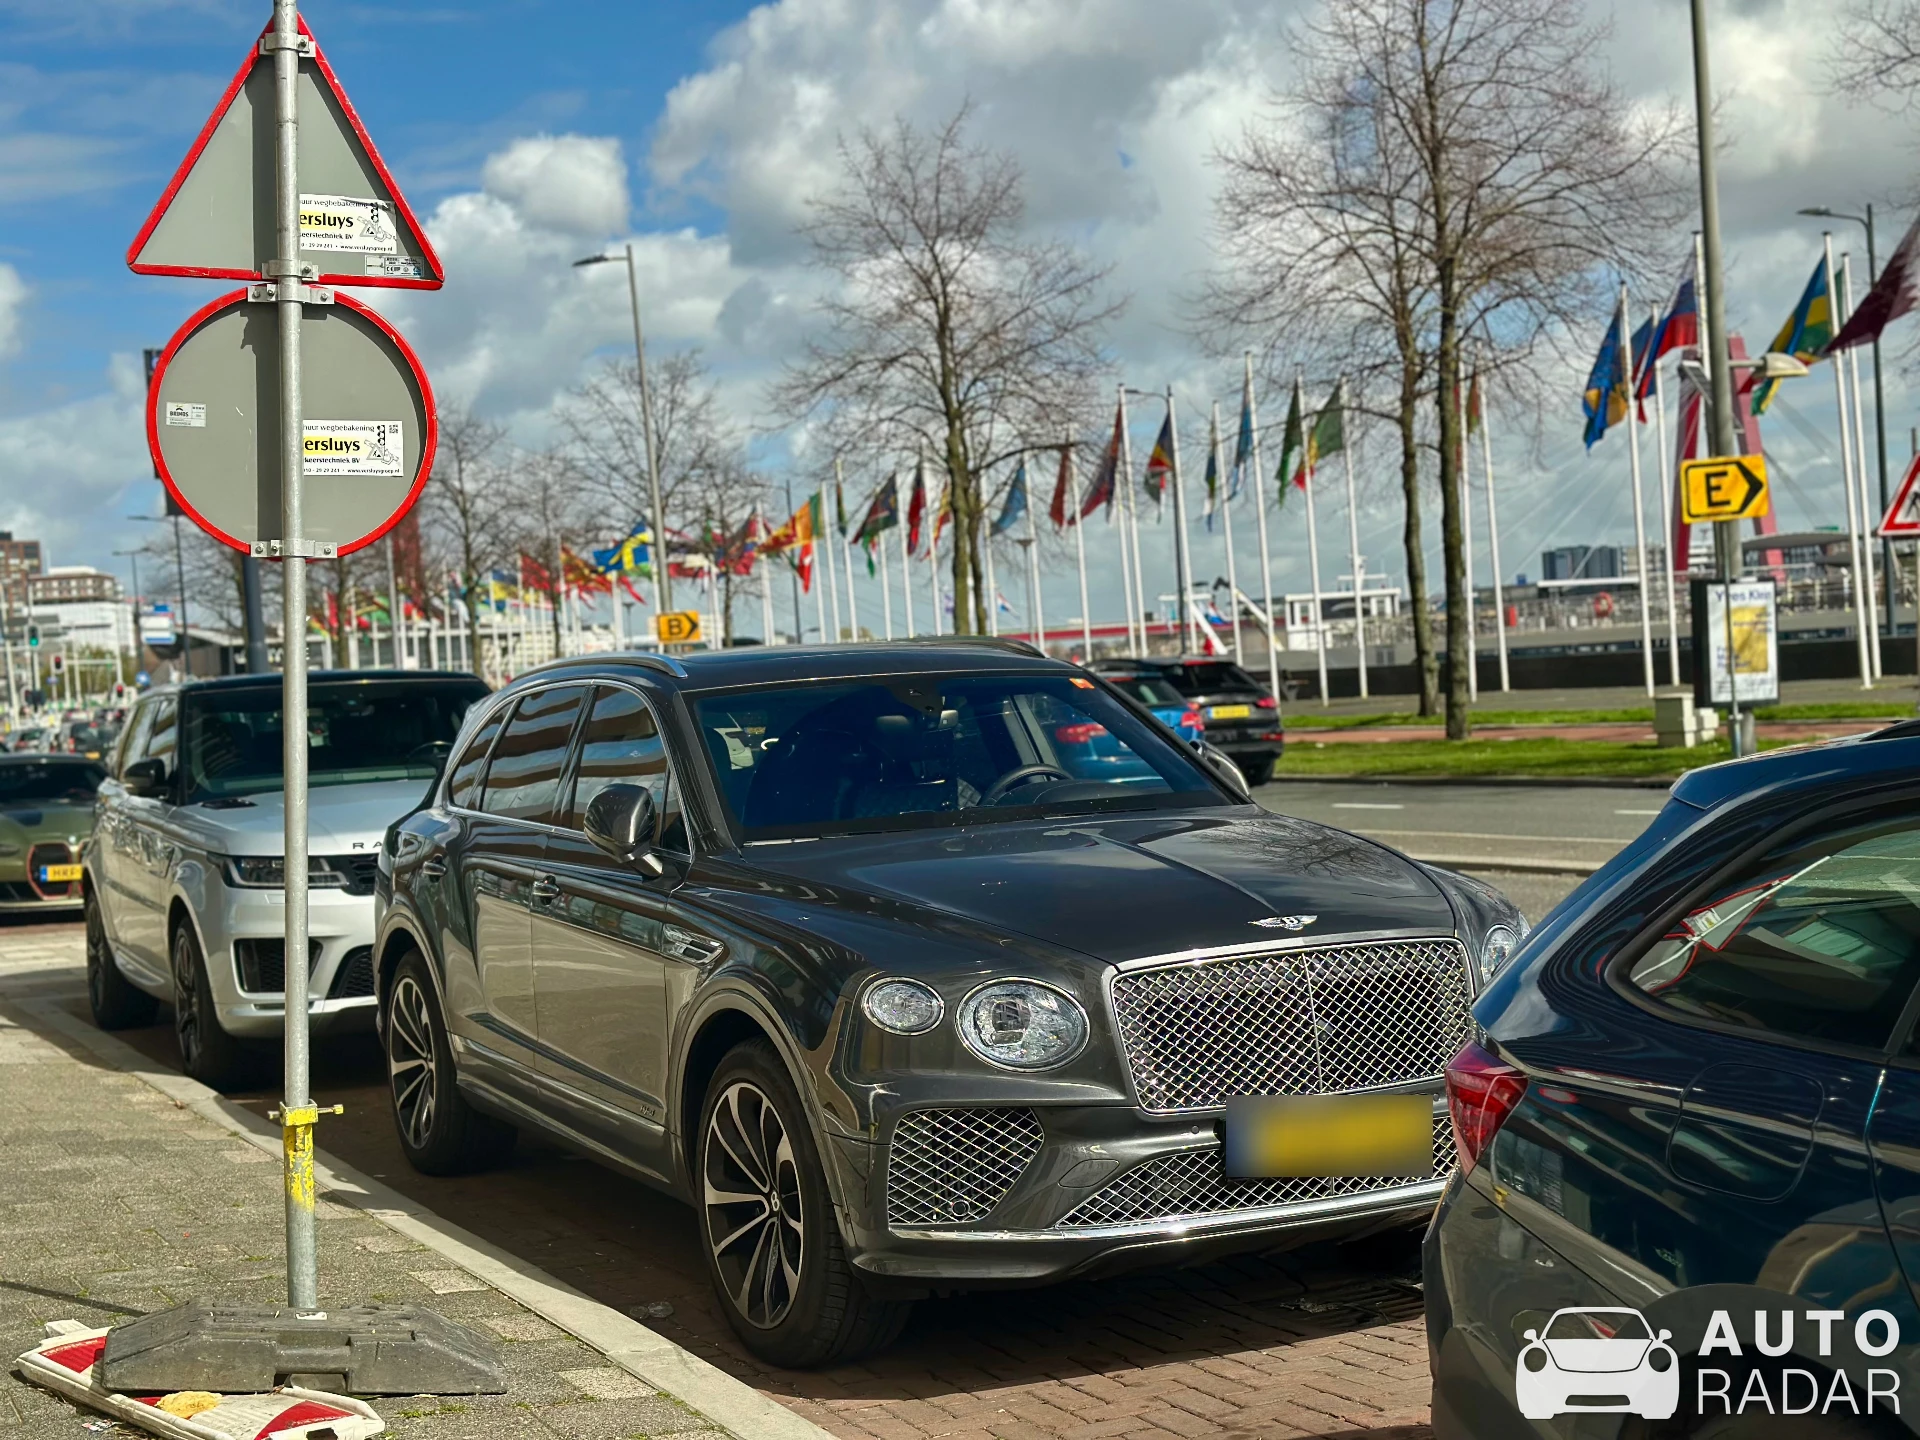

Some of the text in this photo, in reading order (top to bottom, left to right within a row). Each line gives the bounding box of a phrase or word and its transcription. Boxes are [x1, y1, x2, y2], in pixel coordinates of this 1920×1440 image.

[300, 232, 344, 240] eerstechniek
[320, 424, 375, 433] wegbebakening
[1704, 470, 1731, 508] E
[668, 618, 683, 636] B
